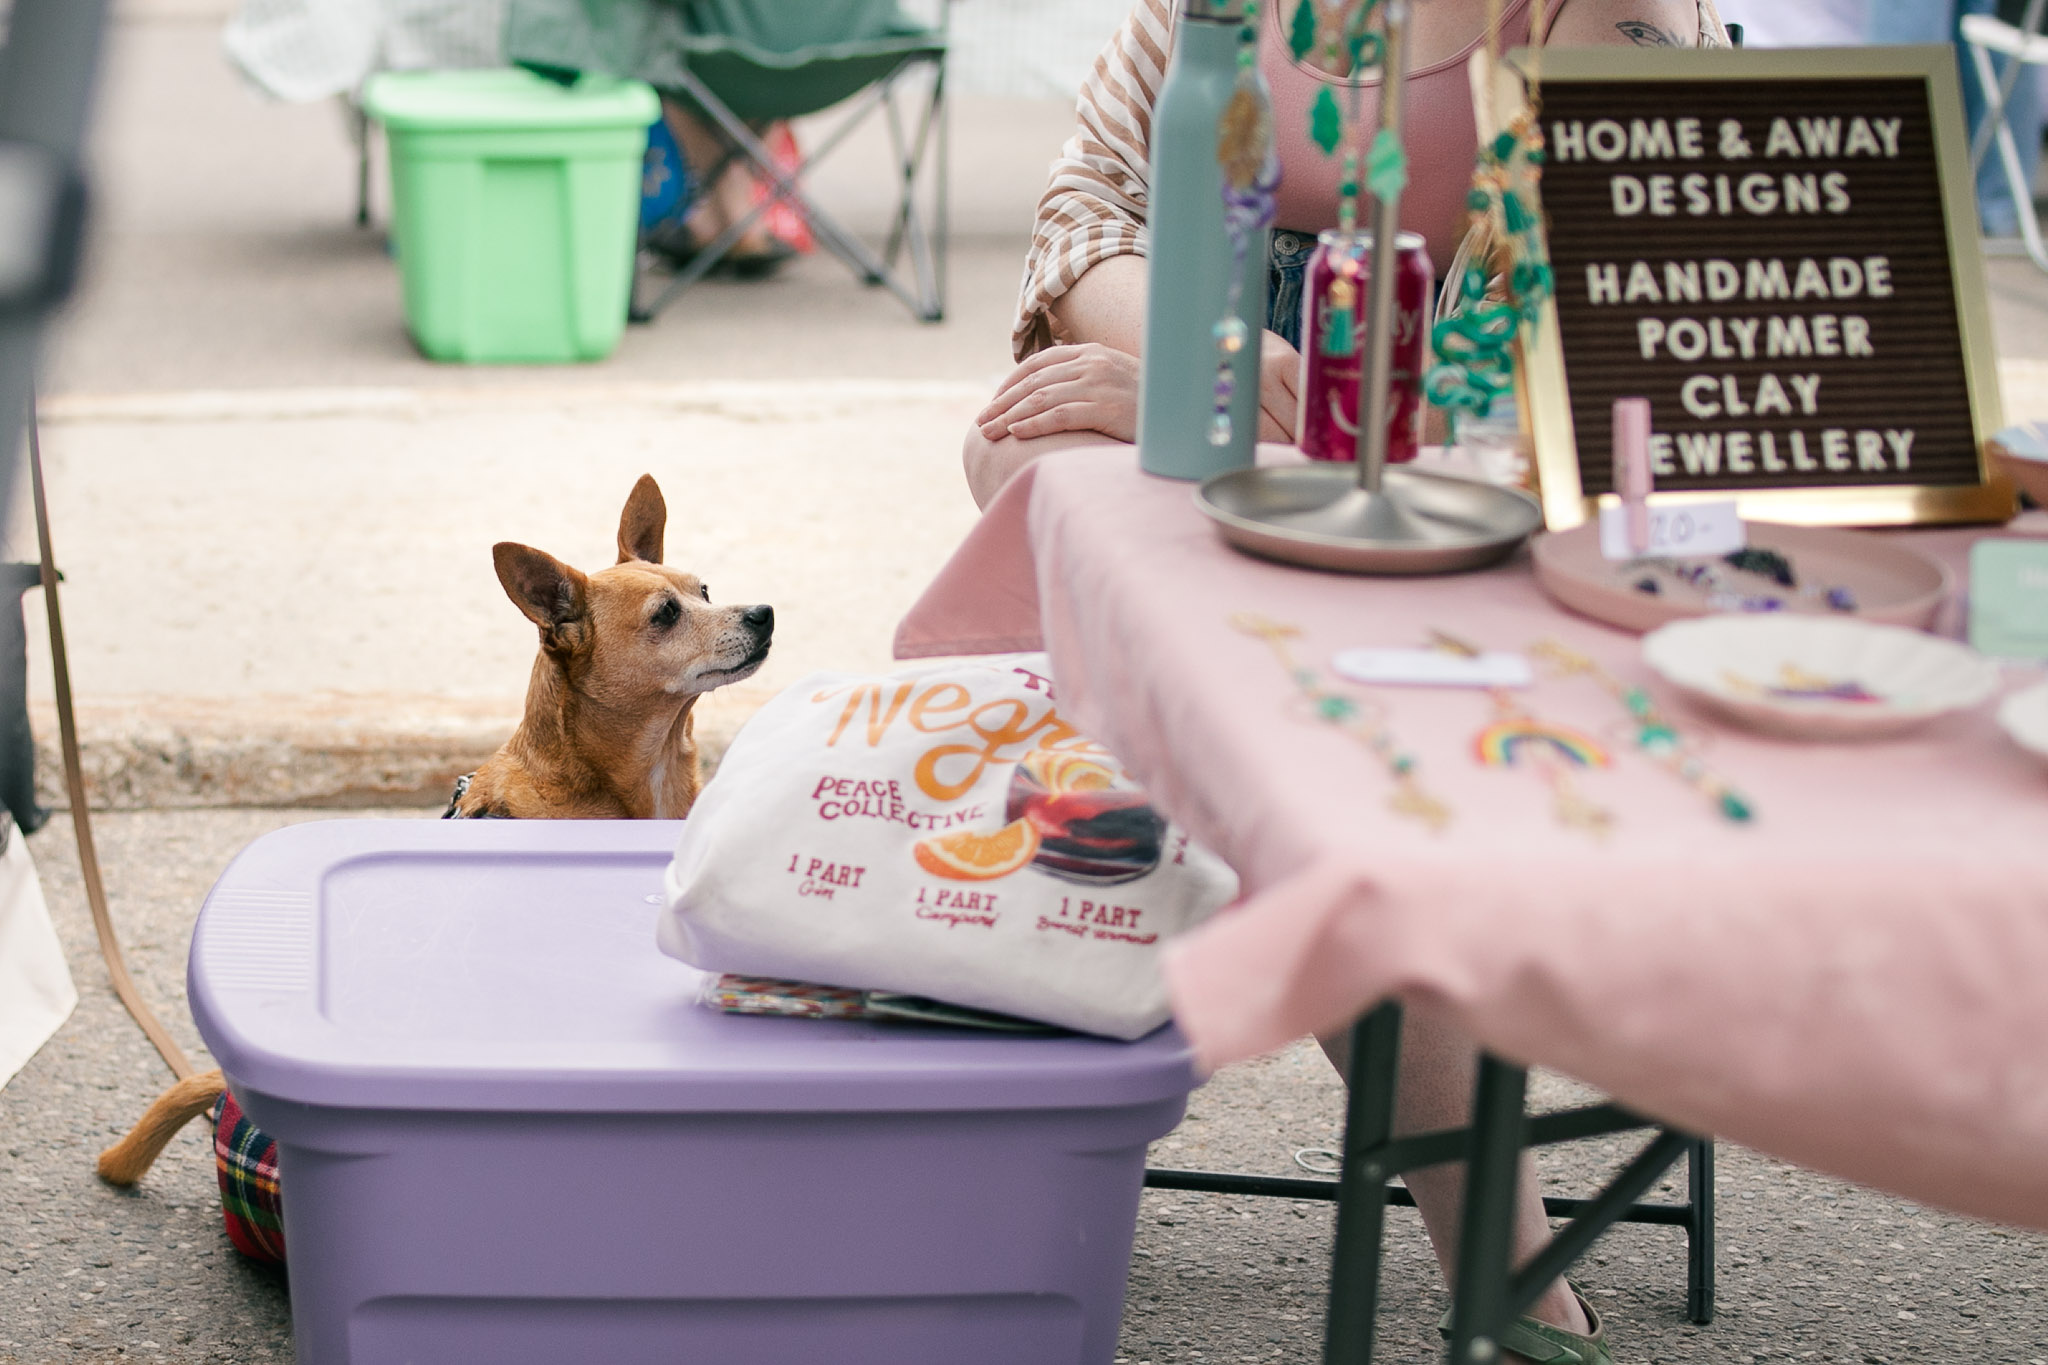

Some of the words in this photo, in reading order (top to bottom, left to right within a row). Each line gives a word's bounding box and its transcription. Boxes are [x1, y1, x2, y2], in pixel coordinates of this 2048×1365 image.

[1552, 118, 1703, 162] HOME
[1717, 119, 1751, 159] &
[1764, 116, 1902, 159] AWAY
[1610, 171, 1852, 217] DESIGNS
[1585, 256, 1894, 305] HANDMADE
[1637, 315, 1874, 361] POLYMER
[1681, 373, 1821, 419] CLAY
[1650, 429, 1915, 476] EWELLERY
[812, 776, 902, 802] PEACE
[819, 800, 986, 831] COLLECTIVE
[787, 853, 800, 874] 1
[805, 857, 867, 889] PART
[798, 878, 836, 901] Gin
[915, 886, 927, 904] 1
[934, 888, 999, 912] PART
[1059, 895, 1069, 917] 1
[1077, 899, 1143, 929] PART
